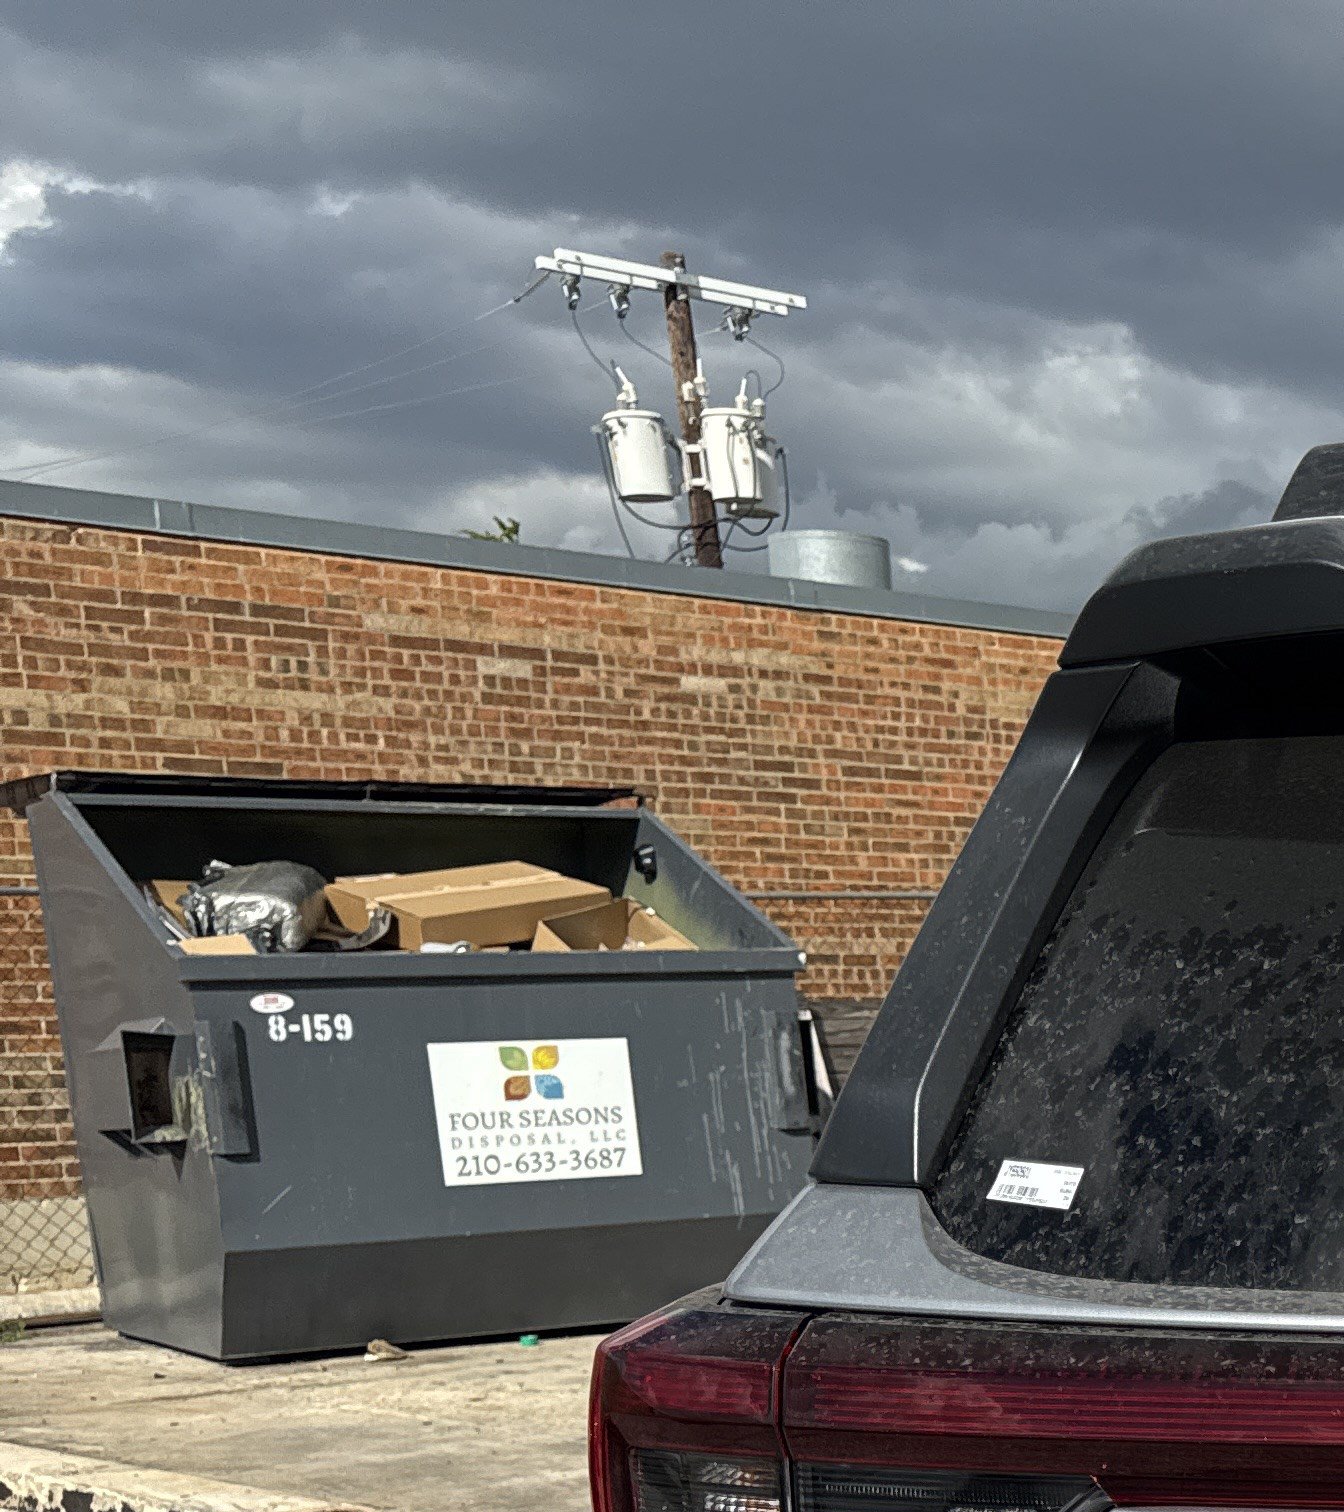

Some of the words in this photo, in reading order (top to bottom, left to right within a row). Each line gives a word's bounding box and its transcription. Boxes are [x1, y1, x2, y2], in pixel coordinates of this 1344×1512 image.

[268, 1013, 353, 1042] 8-159
[449, 1110, 515, 1132] FOUR
[519, 1106, 623, 1129] SEASONS
[590, 1128, 627, 1143] LLC
[456, 1147, 627, 1177] 210-633-3687
